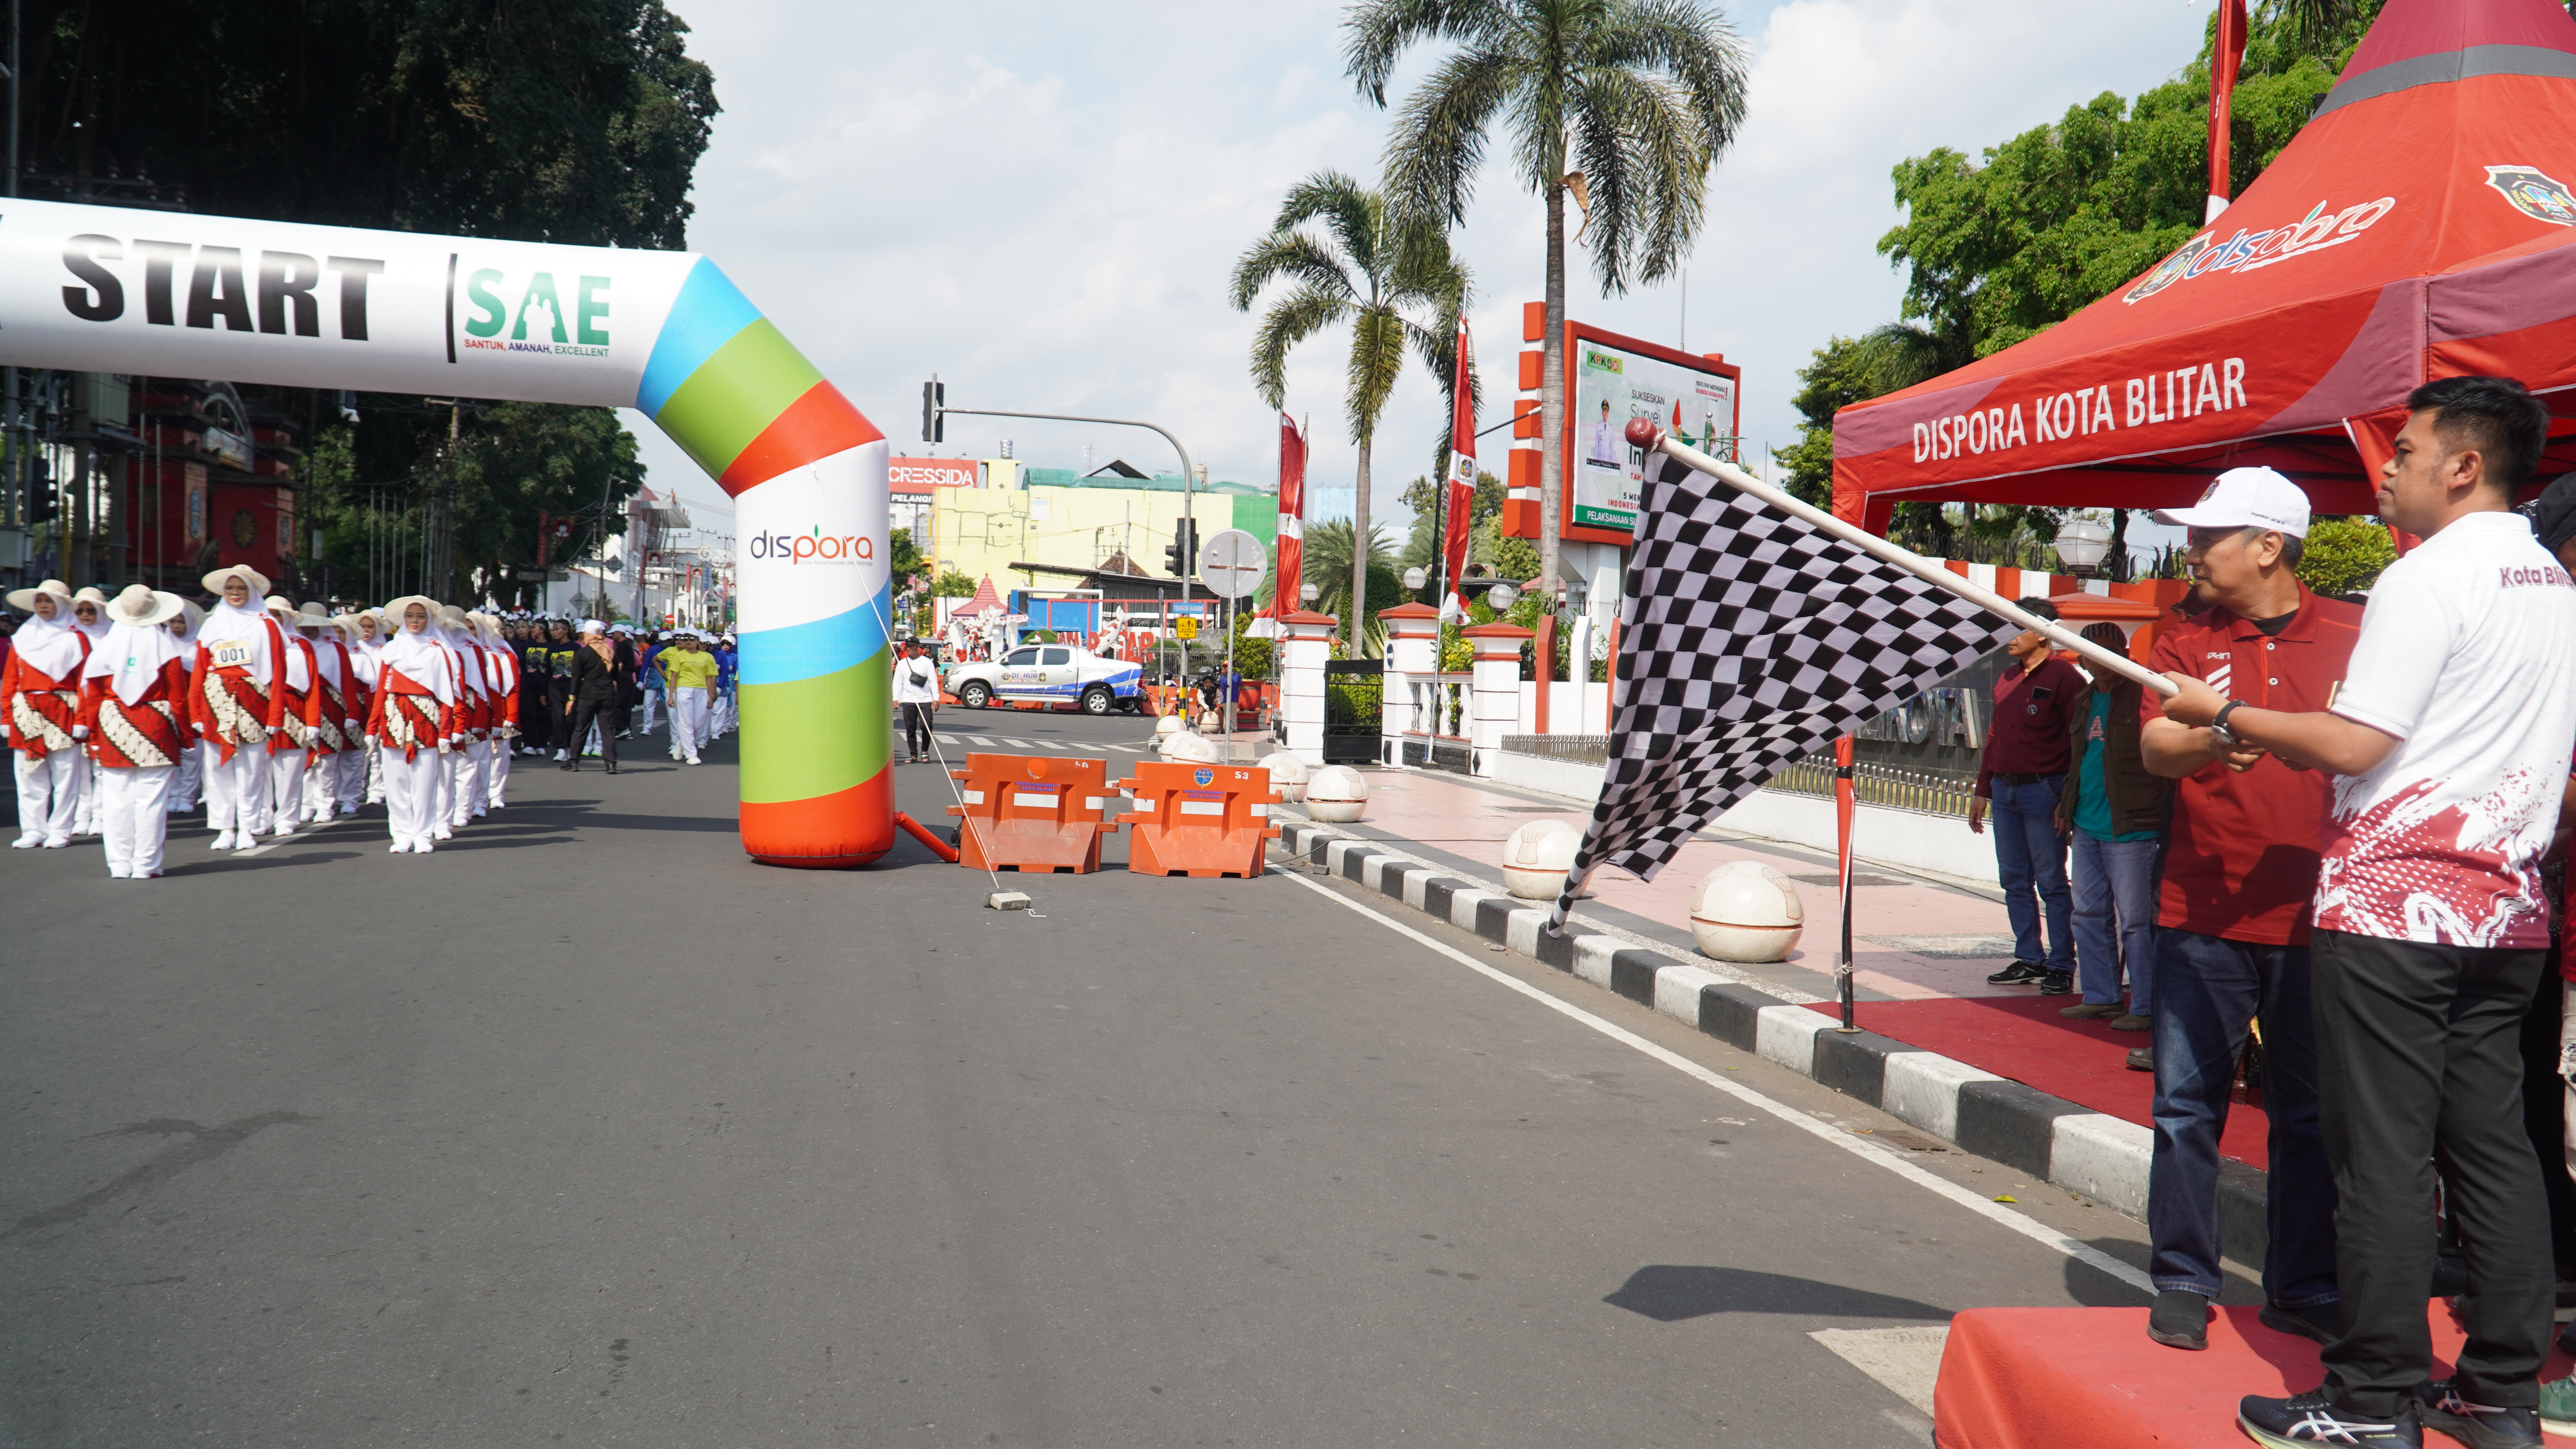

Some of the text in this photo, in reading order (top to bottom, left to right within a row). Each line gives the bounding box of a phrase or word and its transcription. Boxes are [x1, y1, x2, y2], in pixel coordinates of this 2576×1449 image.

[62, 233, 385, 341] START
[465, 268, 611, 346] SAE
[465, 339, 610, 357] SANTUN, AMANAH, EXCELLENT
[1590, 353, 1607, 367] KPK
[1631, 389, 1665, 406] SUKSESKAN
[1631, 403, 1661, 424] Survei
[1914, 357, 2248, 463] DISPORA KOTA BLITAR
[1629, 445, 1641, 466] In
[888, 467, 975, 485] CRESSIDA
[1630, 473, 1642, 481] TAH
[891, 494, 932, 503] PELANGI
[1608, 499, 1639, 510] INDONESIA
[1629, 493, 1640, 501] MEN
[1587, 510, 1629, 525] PELAKSANAAN
[751, 524, 872, 565] dispora
[2499, 565, 2543, 588] Kota
[221, 648, 244, 662] 001
[1235, 771, 1249, 780] 53
